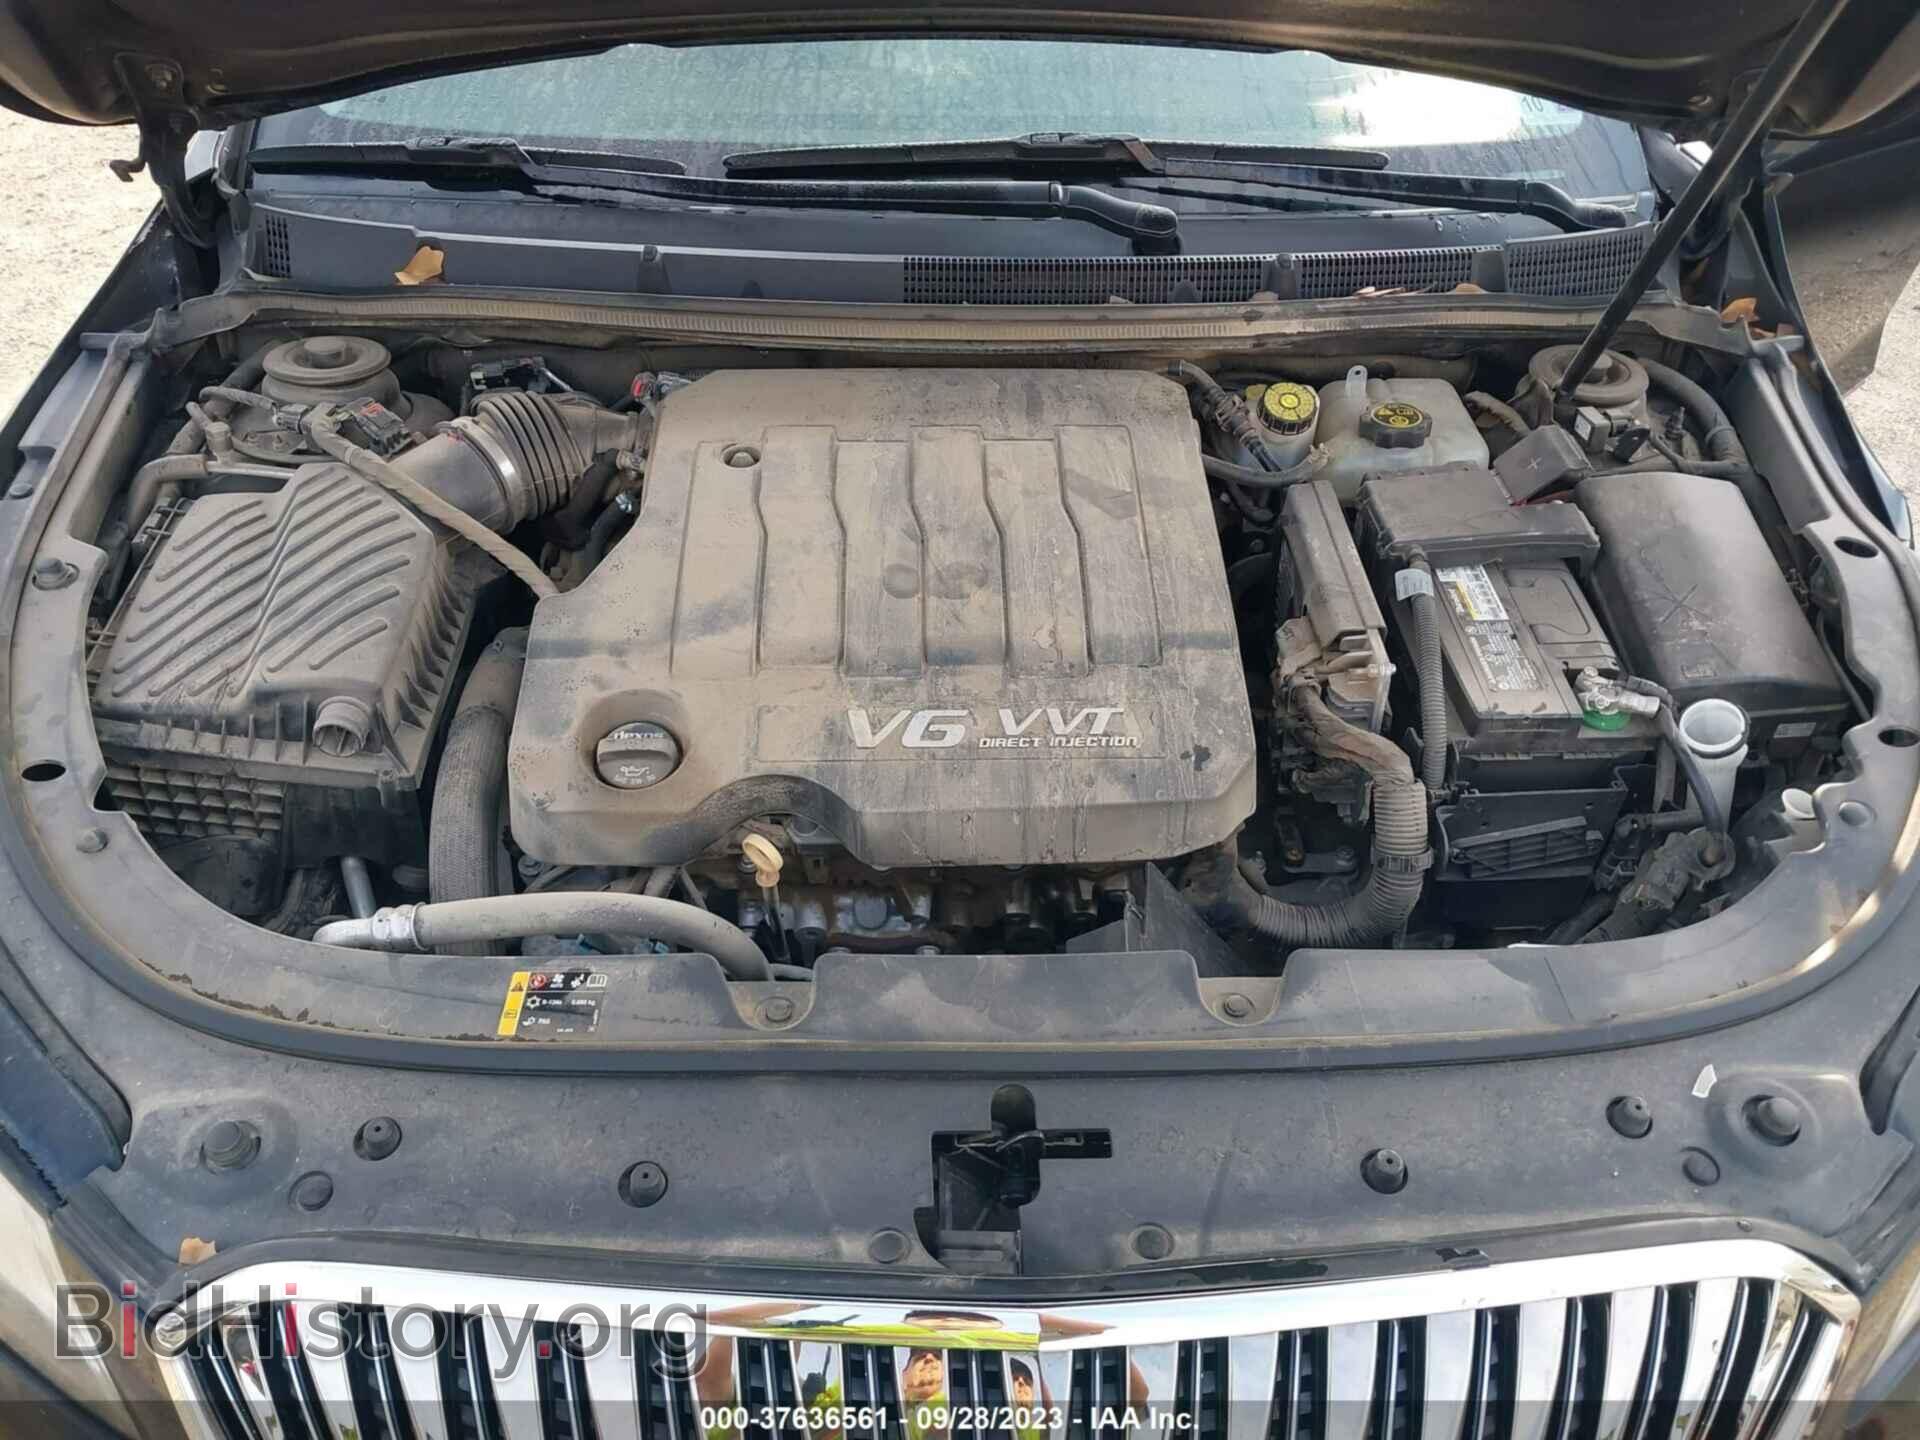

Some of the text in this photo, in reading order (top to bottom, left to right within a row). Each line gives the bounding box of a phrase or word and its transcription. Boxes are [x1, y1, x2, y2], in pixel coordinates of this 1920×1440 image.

[848, 708, 969, 748] V6
[999, 707, 1124, 736] VVT
[978, 735, 1138, 748] DIRECT INJECTION
